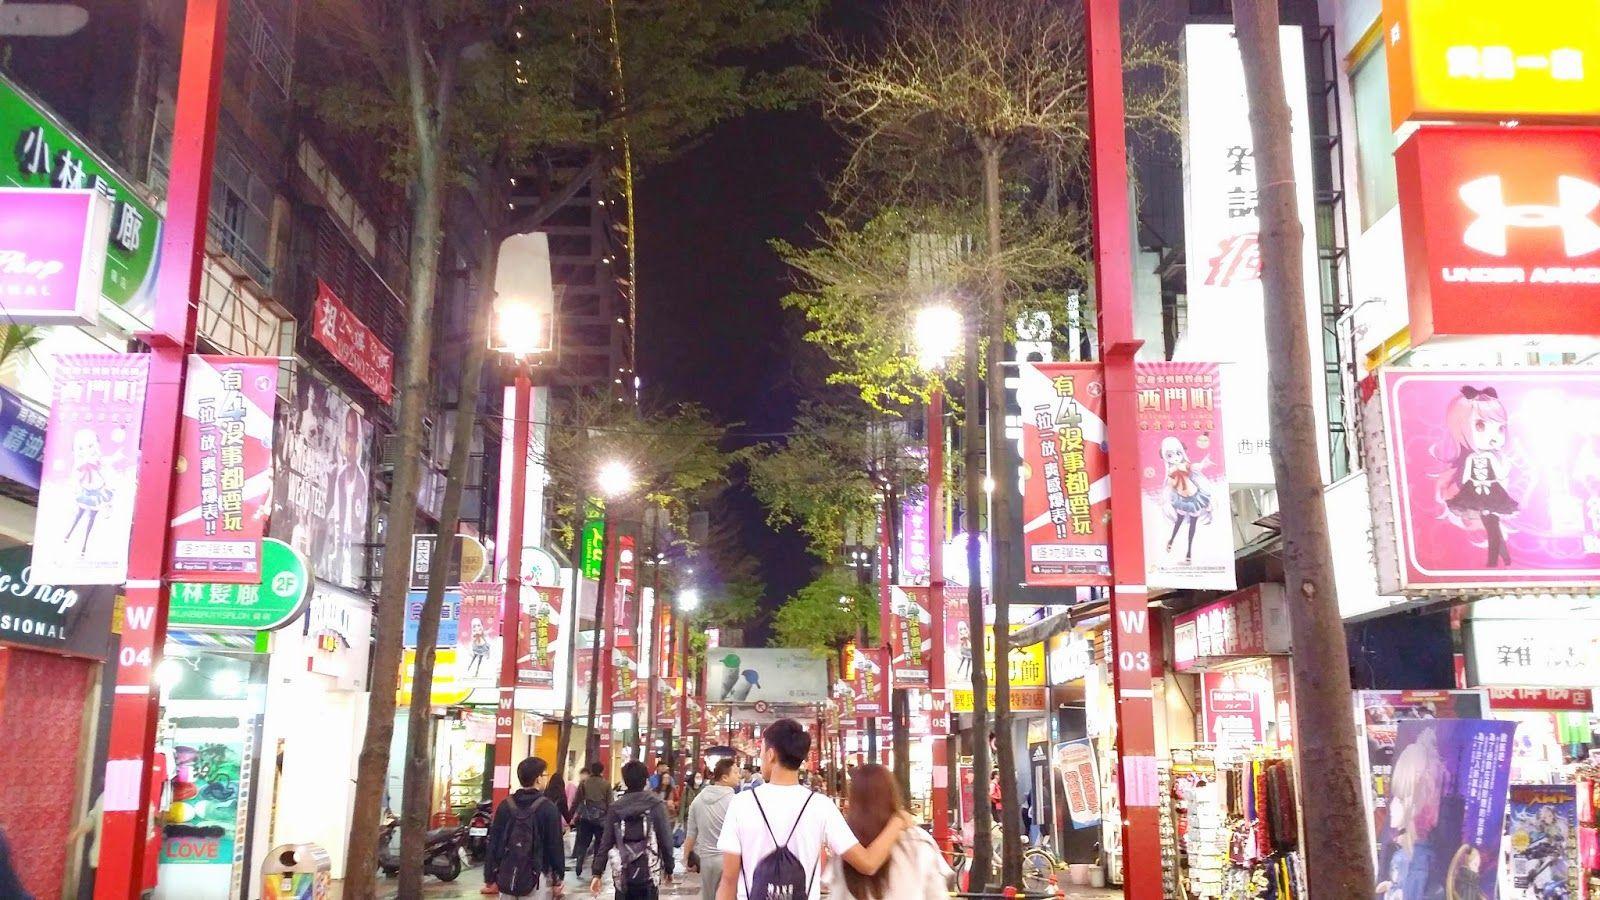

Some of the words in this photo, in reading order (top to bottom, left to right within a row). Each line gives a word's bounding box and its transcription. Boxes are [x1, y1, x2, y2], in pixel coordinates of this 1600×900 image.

[1442, 268, 1525, 283] UNDER
[319, 297, 338, 344] 租
[1137, 386, 1214, 413] 西門町
[2, 424, 46, 461] 精油
[1052, 375, 1093, 535] 有4沒事都要玩
[171, 583, 260, 606] 林髮廊
[276, 577, 295, 594] 2F
[0, 614, 66, 640] SIONAL
[126, 606, 155, 631] W
[1119, 610, 1146, 635] W
[120, 646, 152, 667] 04
[1119, 651, 1151, 672] 03
[500, 698, 513, 710] W
[933, 699, 945, 711] W
[497, 716, 512, 727] 06
[932, 718, 946, 728] 05
[166, 840, 219, 859] LOVE
